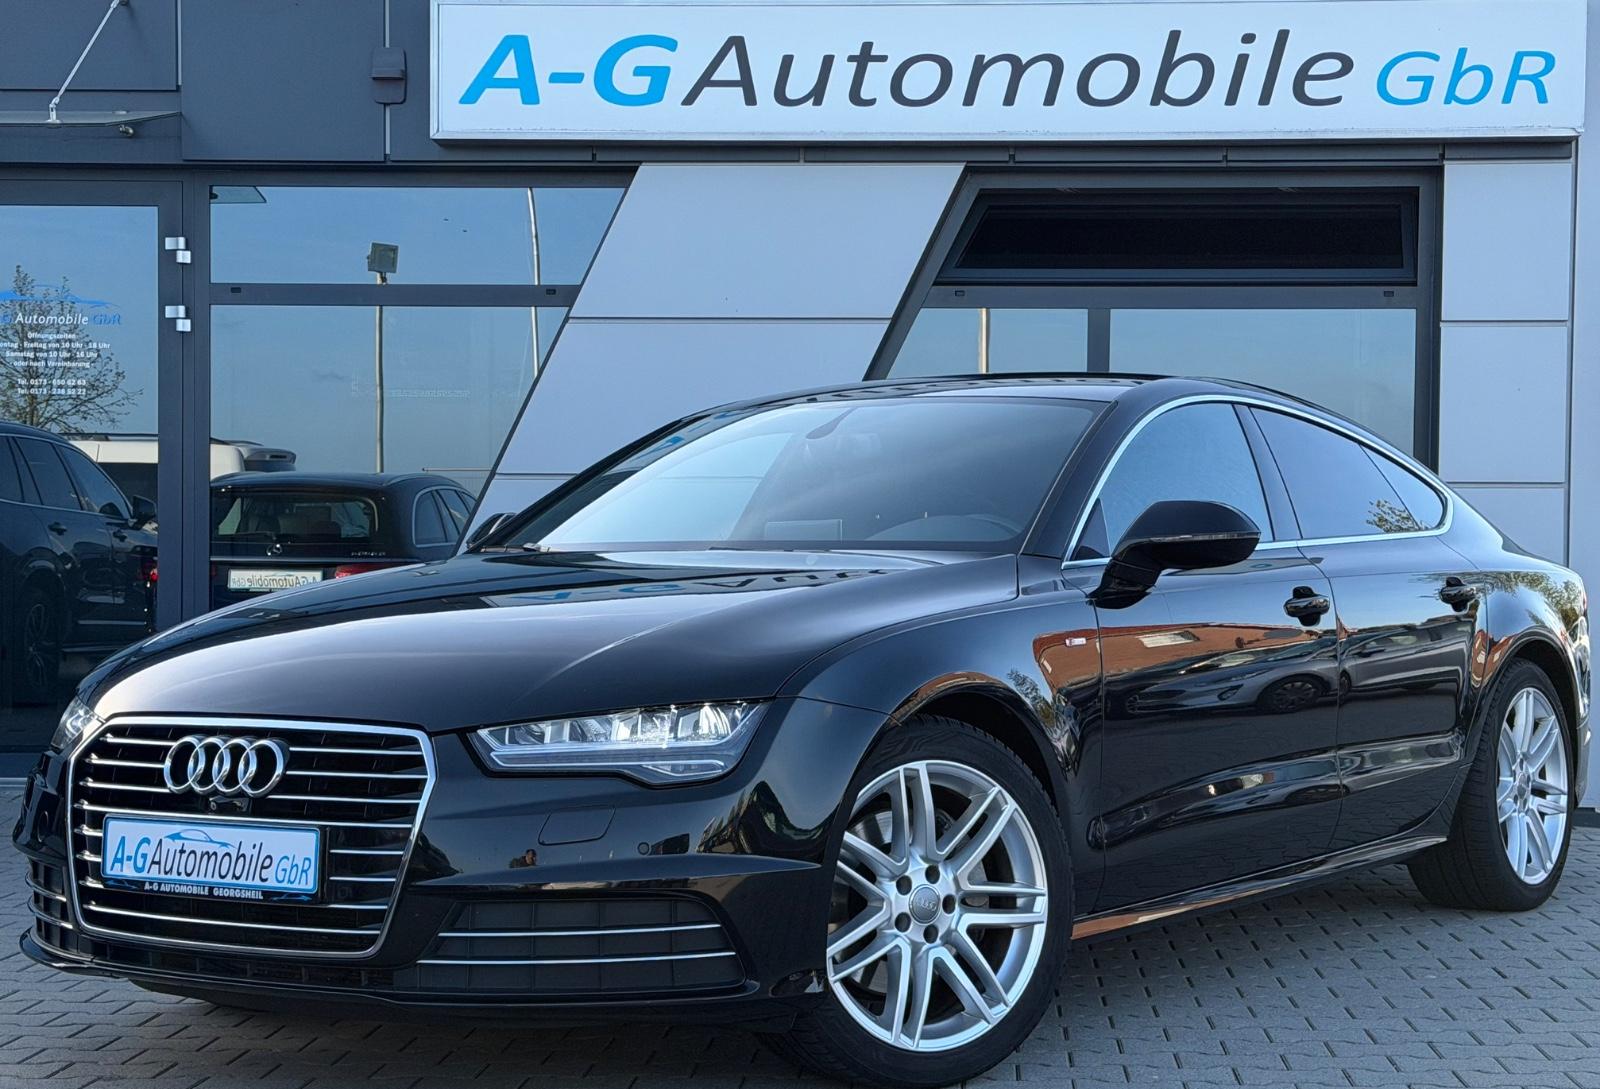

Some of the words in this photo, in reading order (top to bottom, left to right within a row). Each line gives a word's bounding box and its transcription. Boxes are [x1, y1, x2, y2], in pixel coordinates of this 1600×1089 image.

[1376, 47, 1557, 106] GbR
[15, 313, 89, 325] Automobile
[93, 314, 121, 325] GbR
[274, 855, 312, 886] GbR
[144, 883, 159, 892] A-G
[160, 883, 209, 896] AUTOMOBILE
[213, 887, 263, 900] GEORGSHEIL
